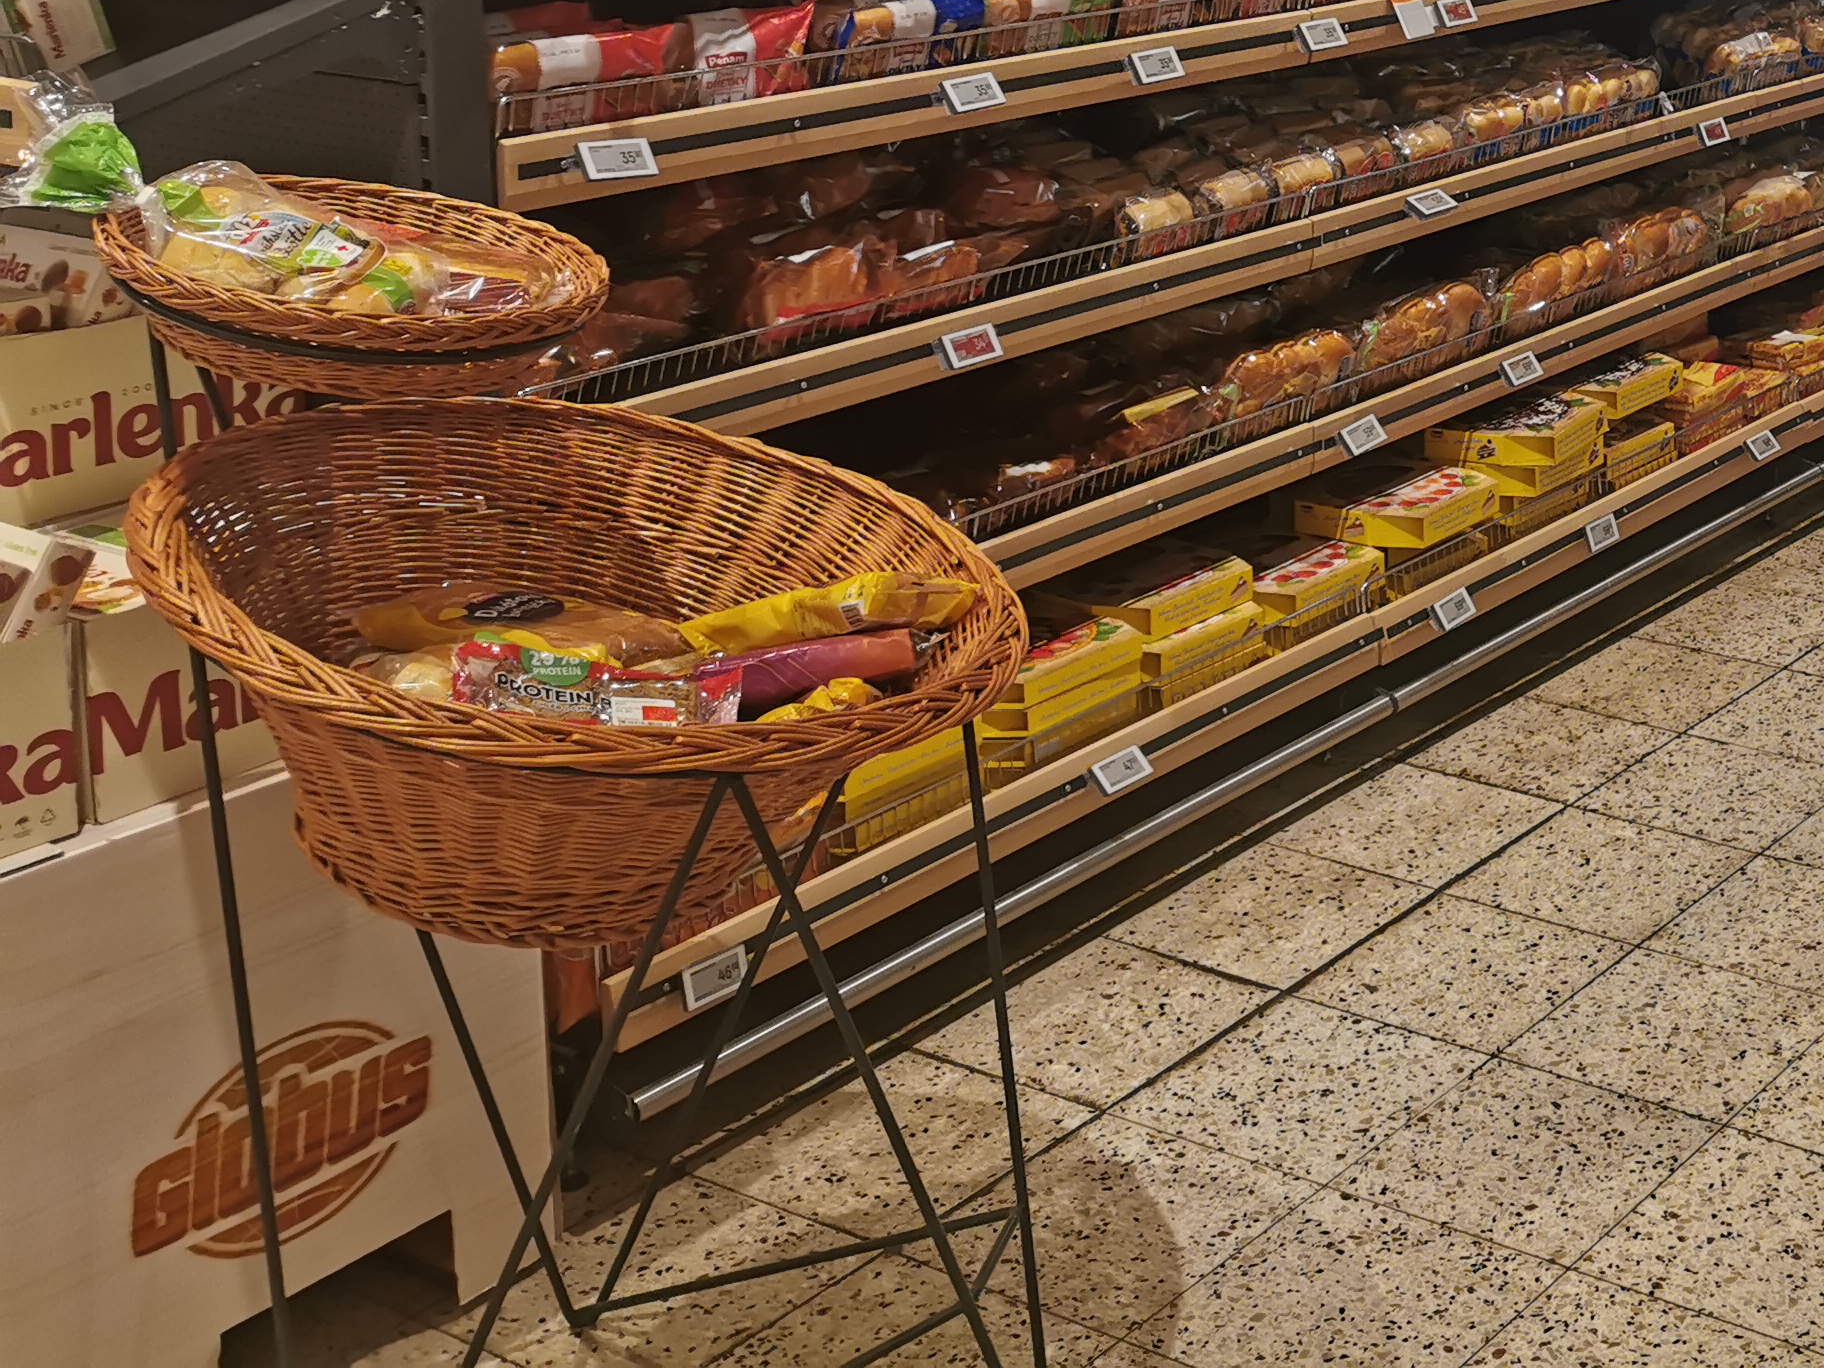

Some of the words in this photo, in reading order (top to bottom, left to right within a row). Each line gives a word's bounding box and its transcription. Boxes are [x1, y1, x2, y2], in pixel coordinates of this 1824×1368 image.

[120, 382, 153, 397] 200
[29, 397, 84, 416] SINCE
[532, 666, 581, 676] PROTEIN
[495, 672, 593, 704] PROTEIN
